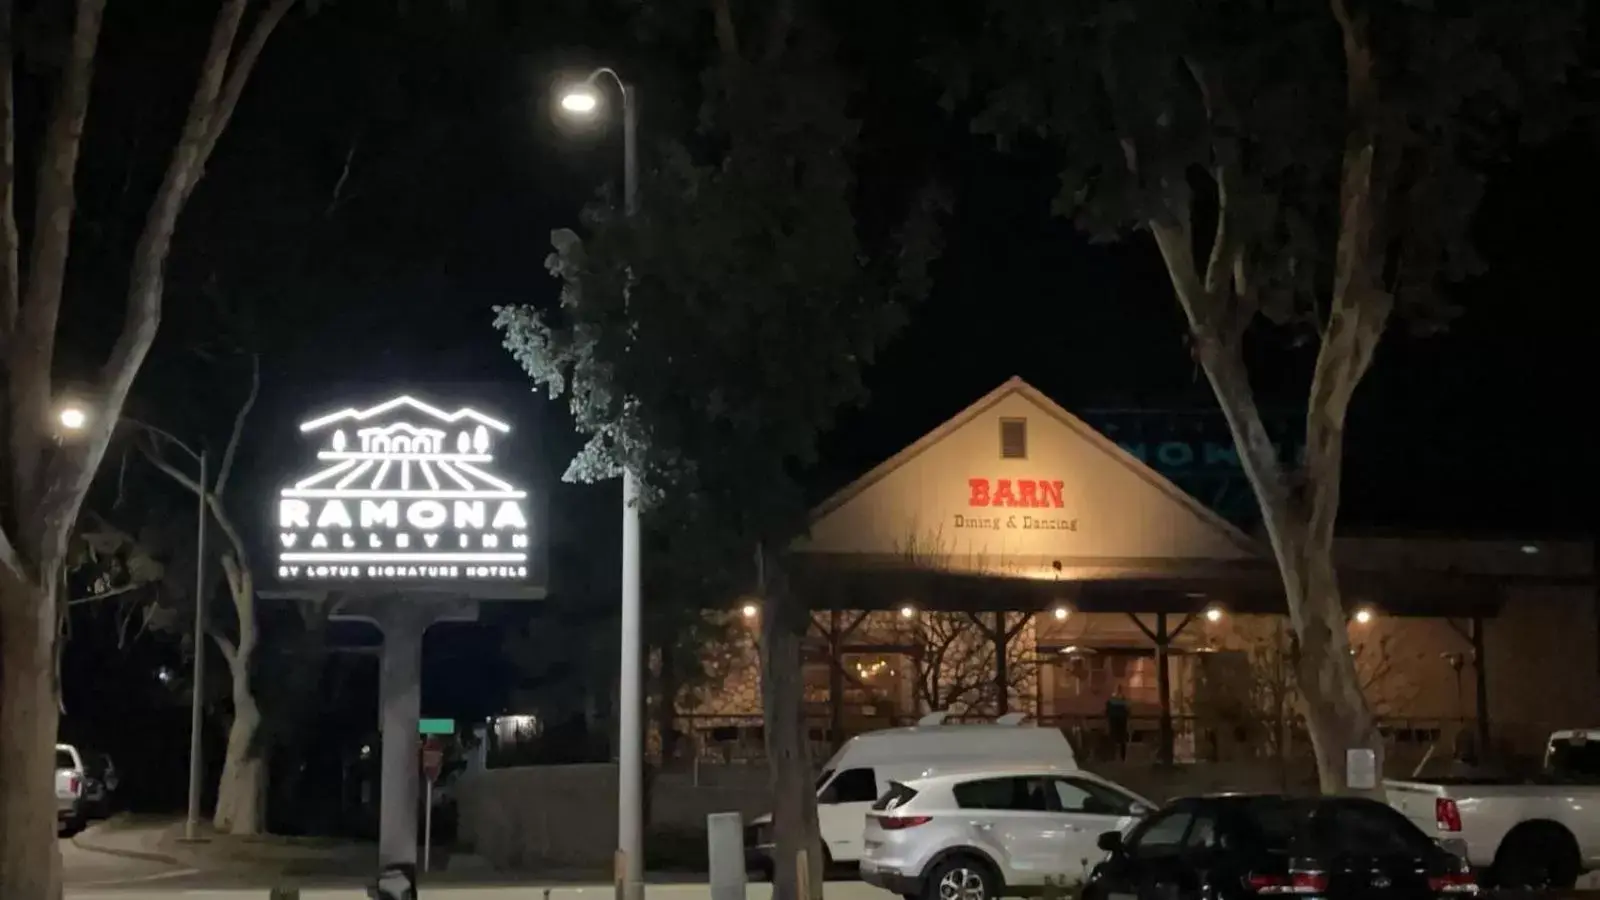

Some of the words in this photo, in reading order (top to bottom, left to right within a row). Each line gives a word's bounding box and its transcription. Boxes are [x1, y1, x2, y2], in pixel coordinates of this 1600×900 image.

[968, 478, 1065, 508] BARN
[279, 499, 527, 529] RAMONA
[954, 514, 1000, 530] Dining
[1006, 515, 1017, 529] &
[1022, 515, 1078, 532] Dancing
[280, 532, 440, 548] VALLEY
[459, 532, 528, 548] INN
[279, 565, 299, 577] BY
[307, 565, 360, 577] LOTUS
[367, 565, 459, 577] SIGNATURE
[466, 565, 527, 577] HOTELS
